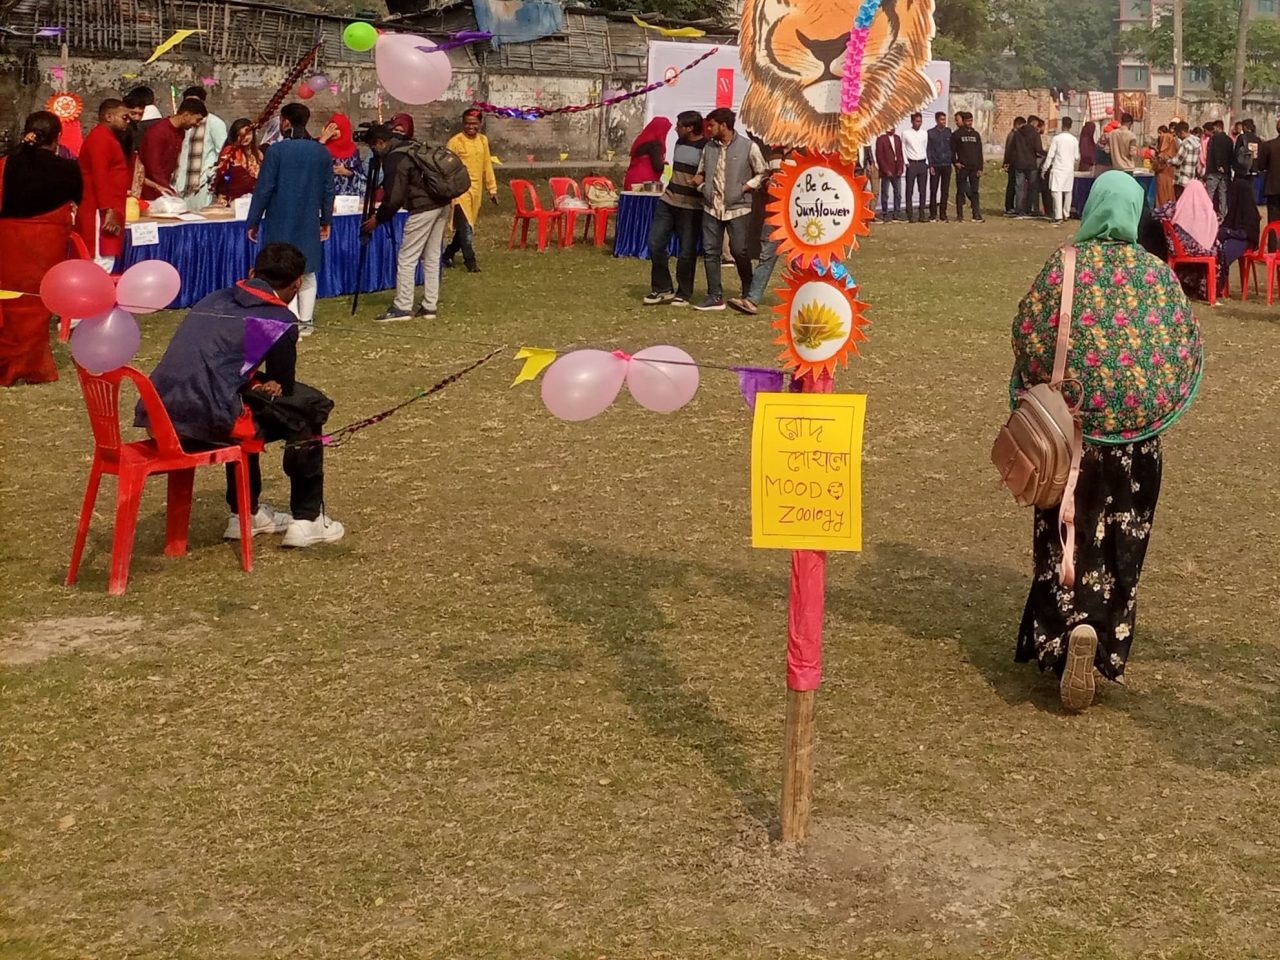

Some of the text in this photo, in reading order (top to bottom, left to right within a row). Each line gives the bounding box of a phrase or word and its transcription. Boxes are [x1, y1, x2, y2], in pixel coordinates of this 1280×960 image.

[805, 173, 817, 192] Be
[794, 196, 850, 217] Sunflower
[776, 416, 835, 443] রোদ
[778, 450, 850, 473] পোহানো
[764, 474, 823, 499] MOOD
[777, 505, 844, 532] Zoology
